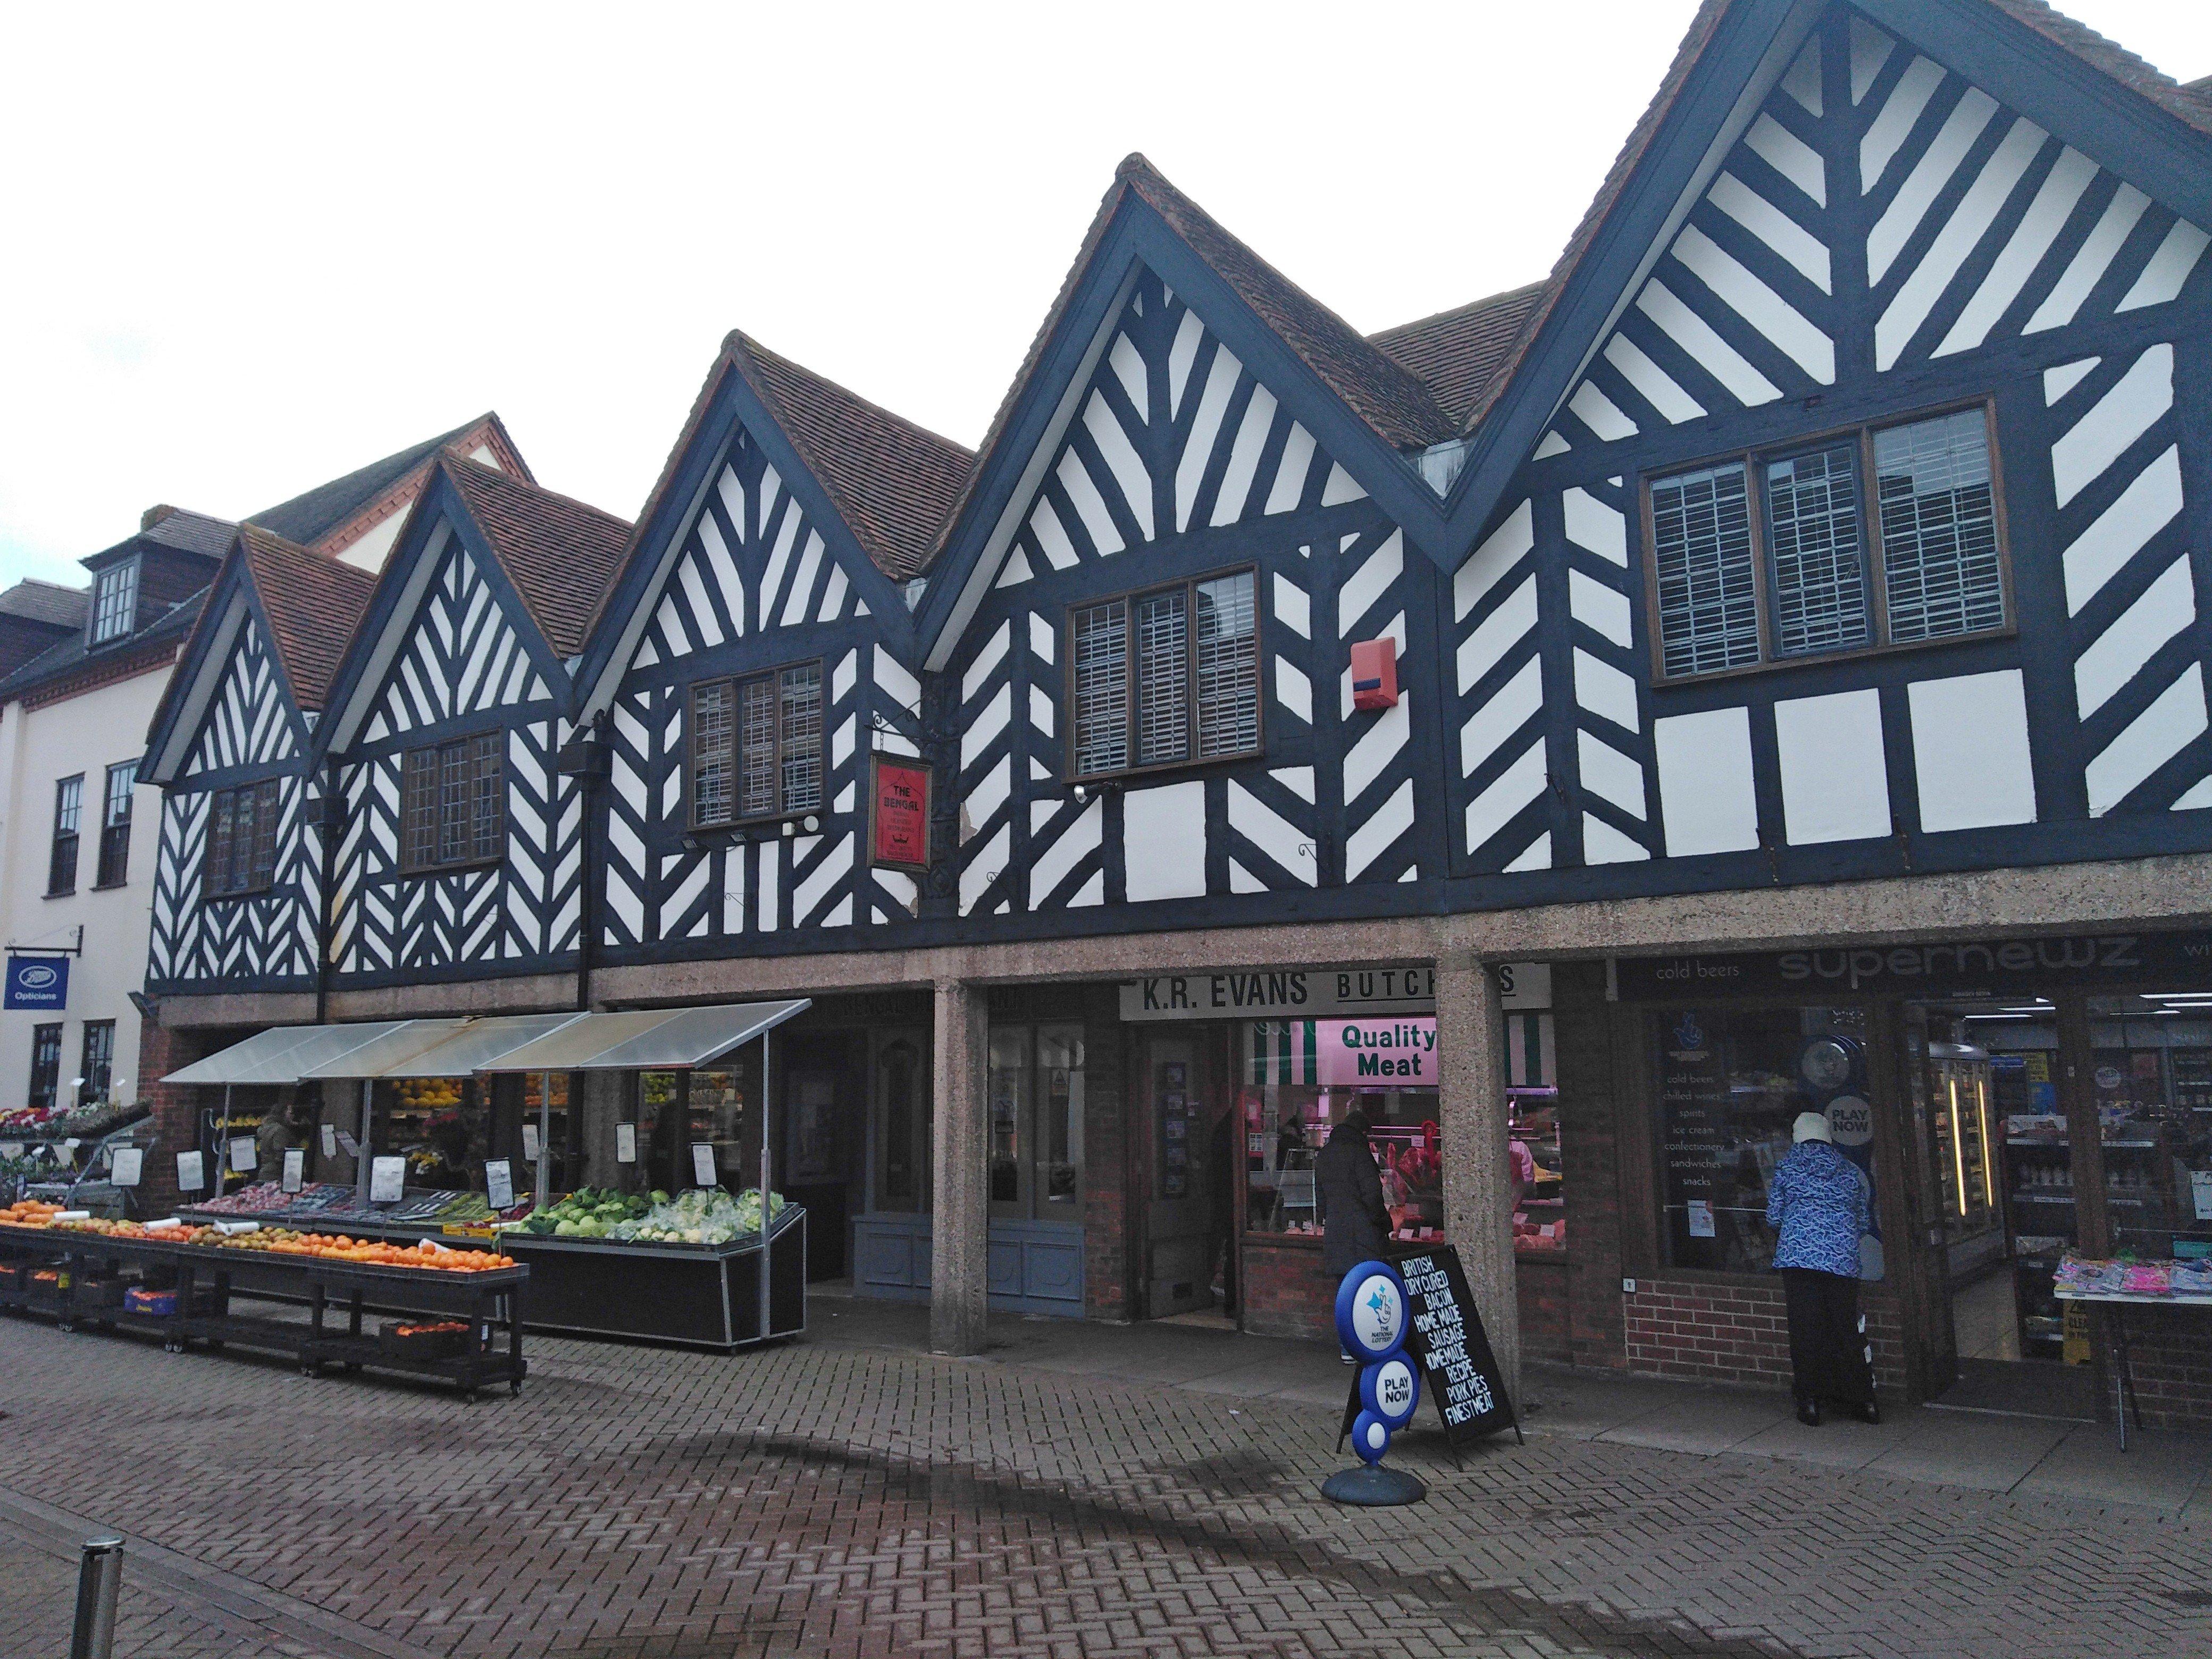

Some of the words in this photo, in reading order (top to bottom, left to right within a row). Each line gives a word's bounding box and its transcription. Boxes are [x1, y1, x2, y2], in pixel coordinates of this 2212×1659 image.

[894, 786, 910, 797] THE
[884, 797, 918, 811] BENGAL
[1657, 961, 1689, 979] cold
[1697, 960, 1739, 977] beers
[1779, 937, 2140, 989] supernewz
[1337, 965, 1514, 998] BUTCHS
[14, 991, 57, 1000] Opticians
[1144, 977, 1197, 1010] K.R.
[1211, 973, 1308, 1007] EVANS
[1342, 1024, 1435, 1052] Quality
[1358, 1052, 1421, 1076] Meat
[1832, 1110, 1868, 1120] PLAY
[1672, 1125, 1686, 1134] ice
[1833, 1121, 1869, 1132] NOW
[1664, 1140, 1725, 1152] confectionery
[1670, 1157, 1721, 1168] sandwiches
[1682, 1175, 1711, 1186] snacks
[1401, 1255, 1435, 1277] BRITISH
[1424, 1287, 1454, 1311] BACON
[1414, 1311, 1440, 1333] HOME
[1437, 1304, 1463, 1327] MADE
[1428, 1322, 1467, 1350] SAUSAGE
[1446, 1359, 1477, 1384] RECIPE
[1385, 1376, 1409, 1391] PLAY
[1446, 1381, 1471, 1405] PORK
[1469, 1375, 1488, 1399] PIES
[1386, 1389, 1409, 1403] NOW
